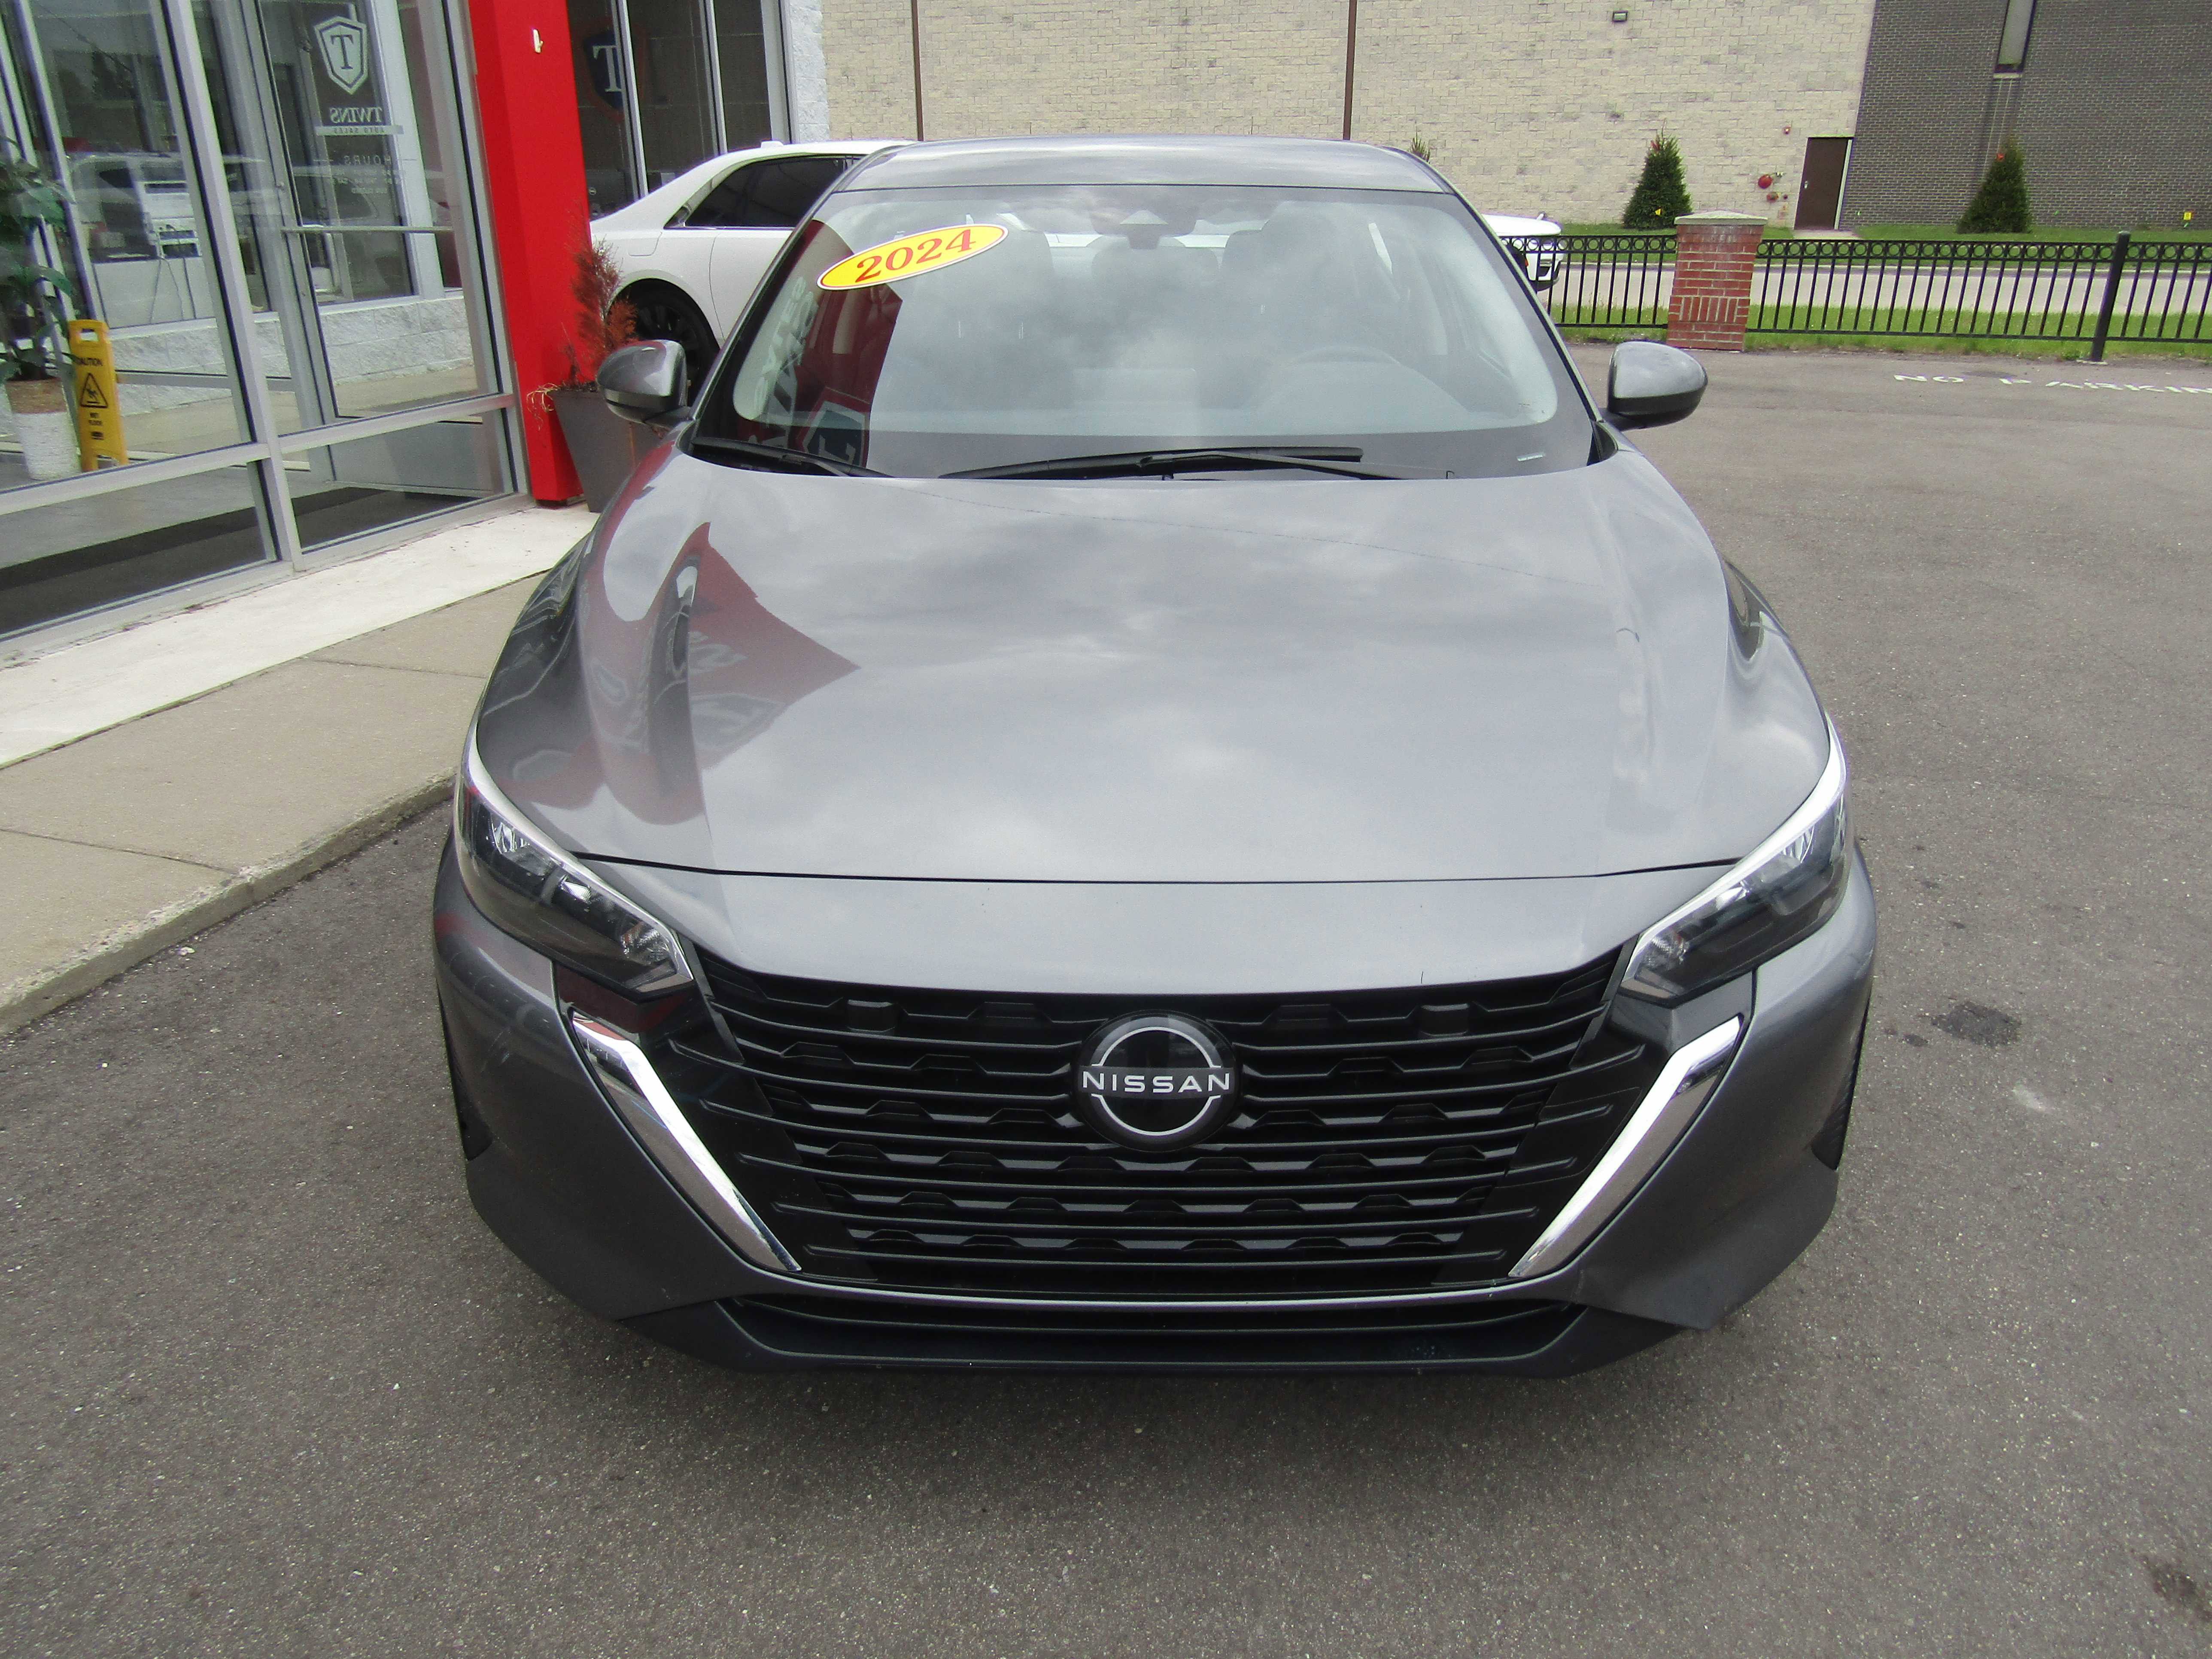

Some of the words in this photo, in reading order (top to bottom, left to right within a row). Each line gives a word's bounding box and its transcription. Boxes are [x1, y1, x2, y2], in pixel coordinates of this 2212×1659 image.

[330, 34, 354, 70] T
[855, 229, 976, 283] 2024
[1893, 374, 1964, 383] NO
[1082, 1071, 1230, 1093] NISSAN
